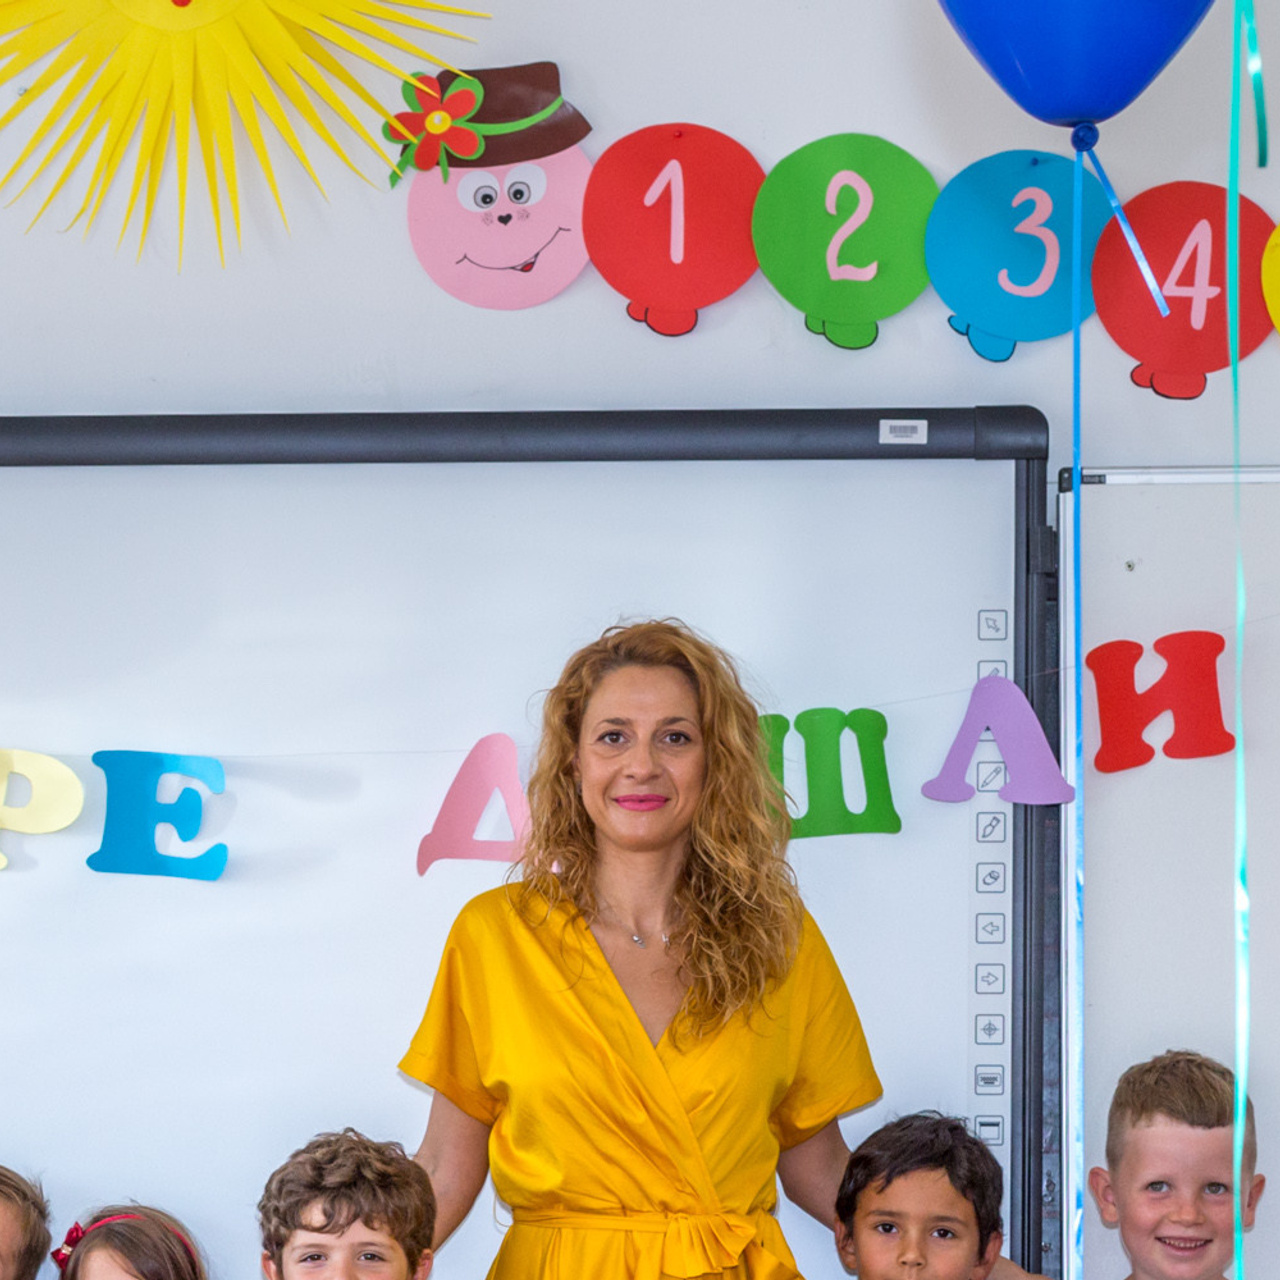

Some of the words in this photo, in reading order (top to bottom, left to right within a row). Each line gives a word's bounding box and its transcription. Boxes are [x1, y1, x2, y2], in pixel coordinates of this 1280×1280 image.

[644, 159, 685, 265] 1
[825, 170, 879, 282] 2
[998, 187, 1061, 297] 3
[1162, 218, 1222, 331] 4
[416, 630, 1236, 877] ДШЛИ
